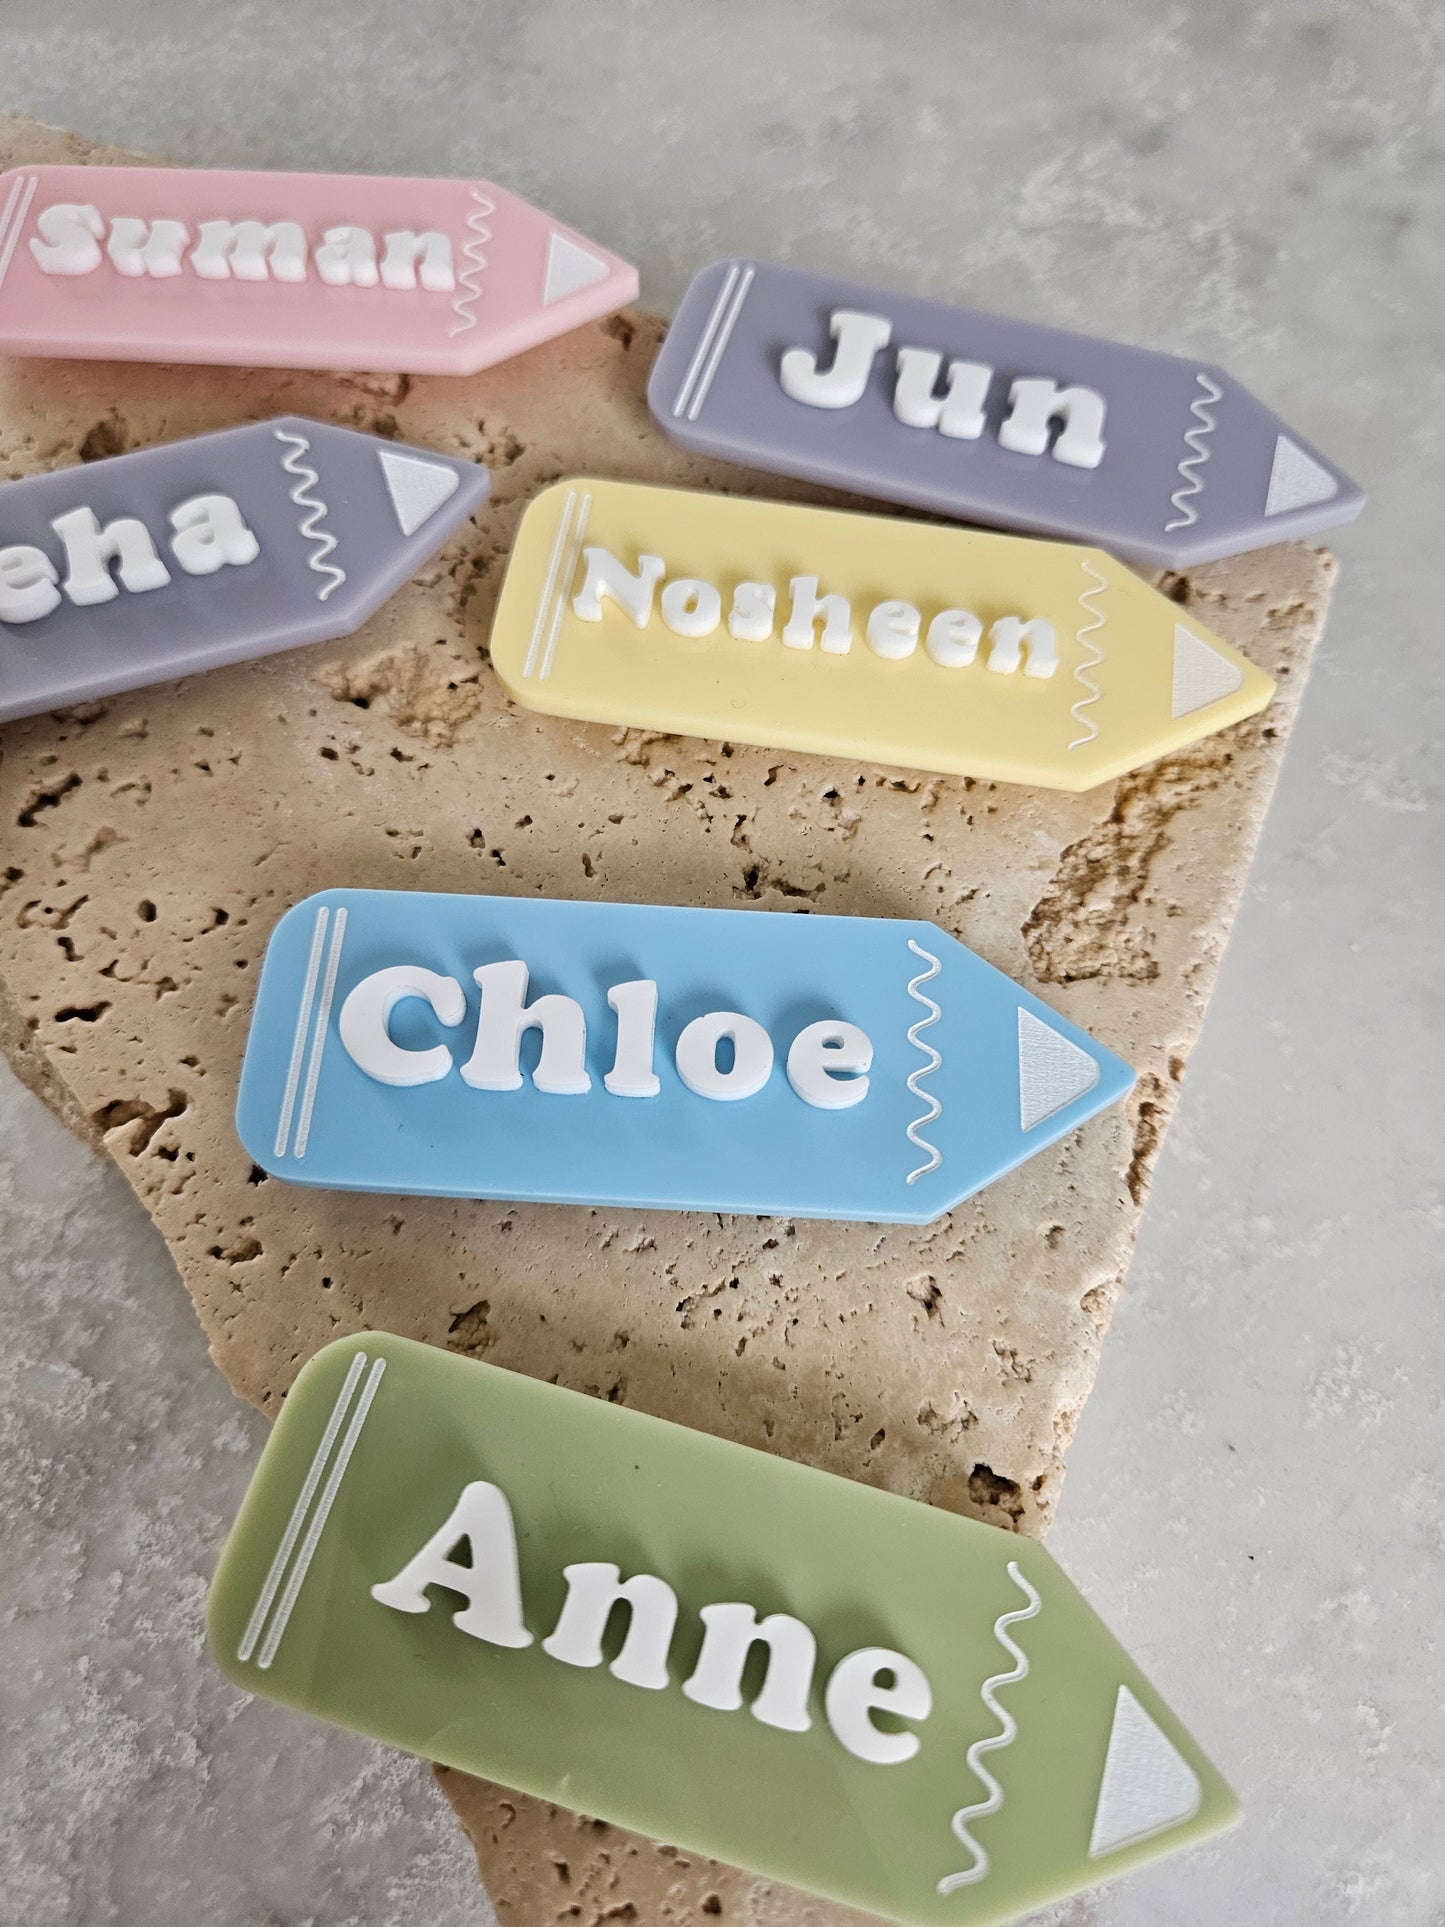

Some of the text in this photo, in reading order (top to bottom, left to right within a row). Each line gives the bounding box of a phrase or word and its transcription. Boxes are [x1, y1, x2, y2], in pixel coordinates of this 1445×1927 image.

[29, 204, 456, 292] Suman
[780, 310, 1107, 468] Jun
[572, 547, 1060, 679] Nosheen
[339, 960, 874, 1110] Chloe
[371, 1480, 934, 1764] Anne
